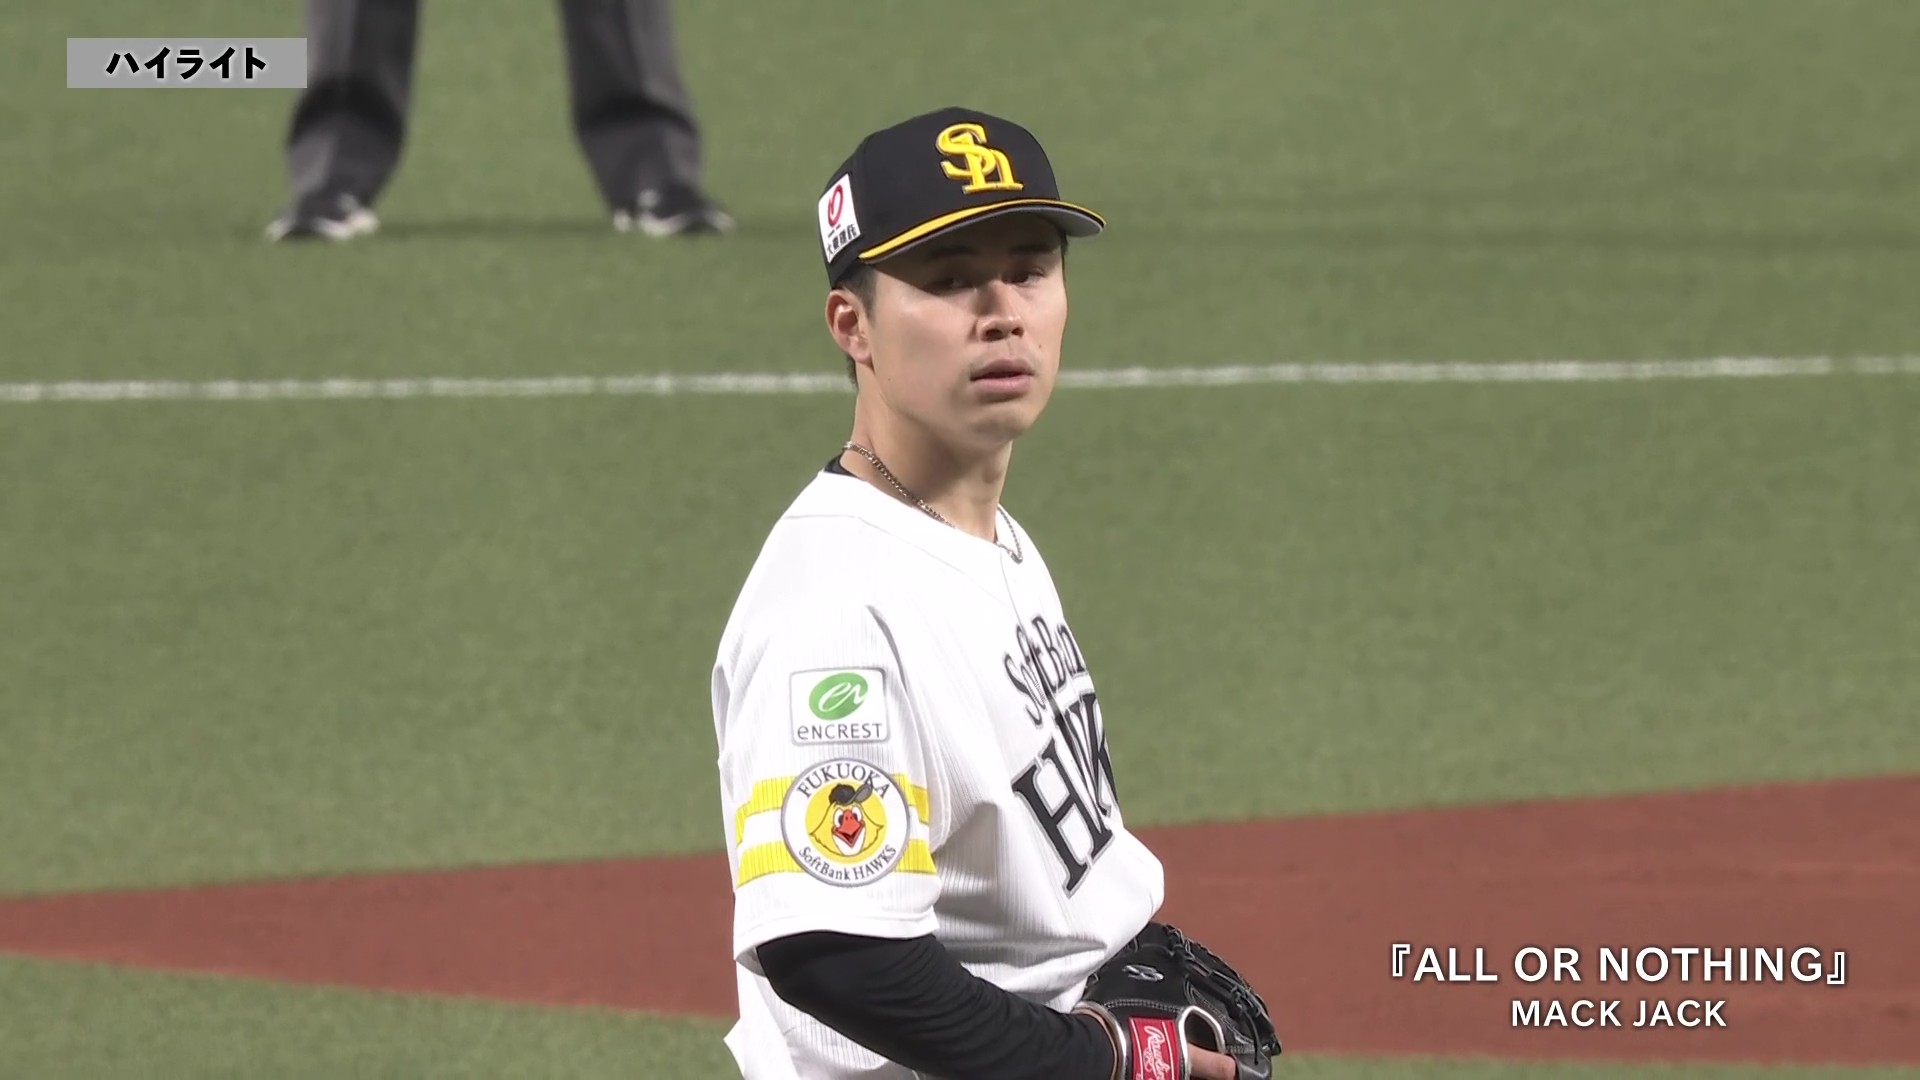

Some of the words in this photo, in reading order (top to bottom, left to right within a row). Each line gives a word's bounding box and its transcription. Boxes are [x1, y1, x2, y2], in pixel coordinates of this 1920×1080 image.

[796, 762, 892, 799] FUKUOKA
[798, 845, 851, 881] SoftBank
[853, 844, 898, 881] HAWKS
